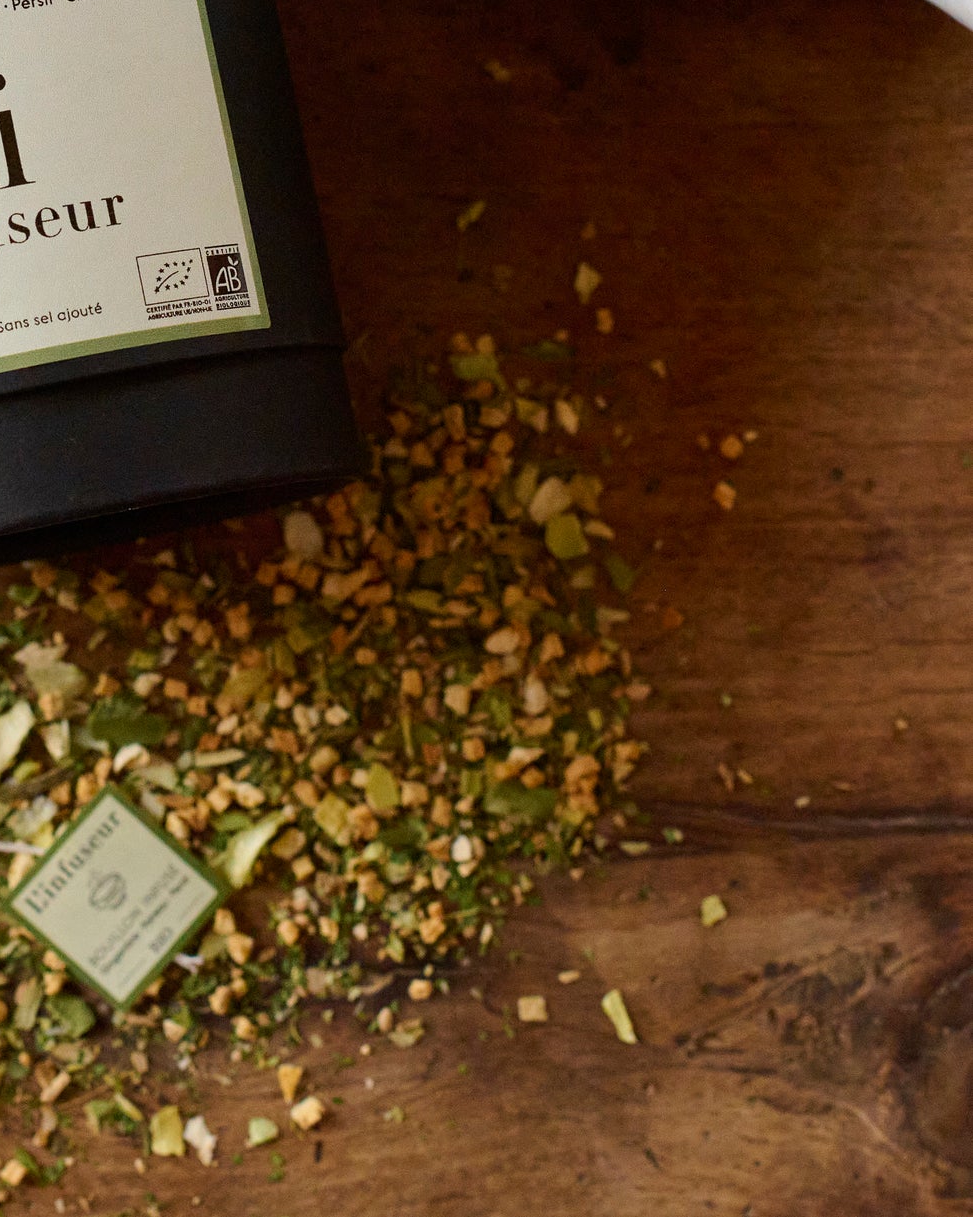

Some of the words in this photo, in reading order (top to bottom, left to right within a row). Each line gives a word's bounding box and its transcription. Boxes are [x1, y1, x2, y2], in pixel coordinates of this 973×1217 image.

[215, 266, 241, 293] AB
[33, 311, 54, 326] sel
[58, 301, 103, 325] ajouté
